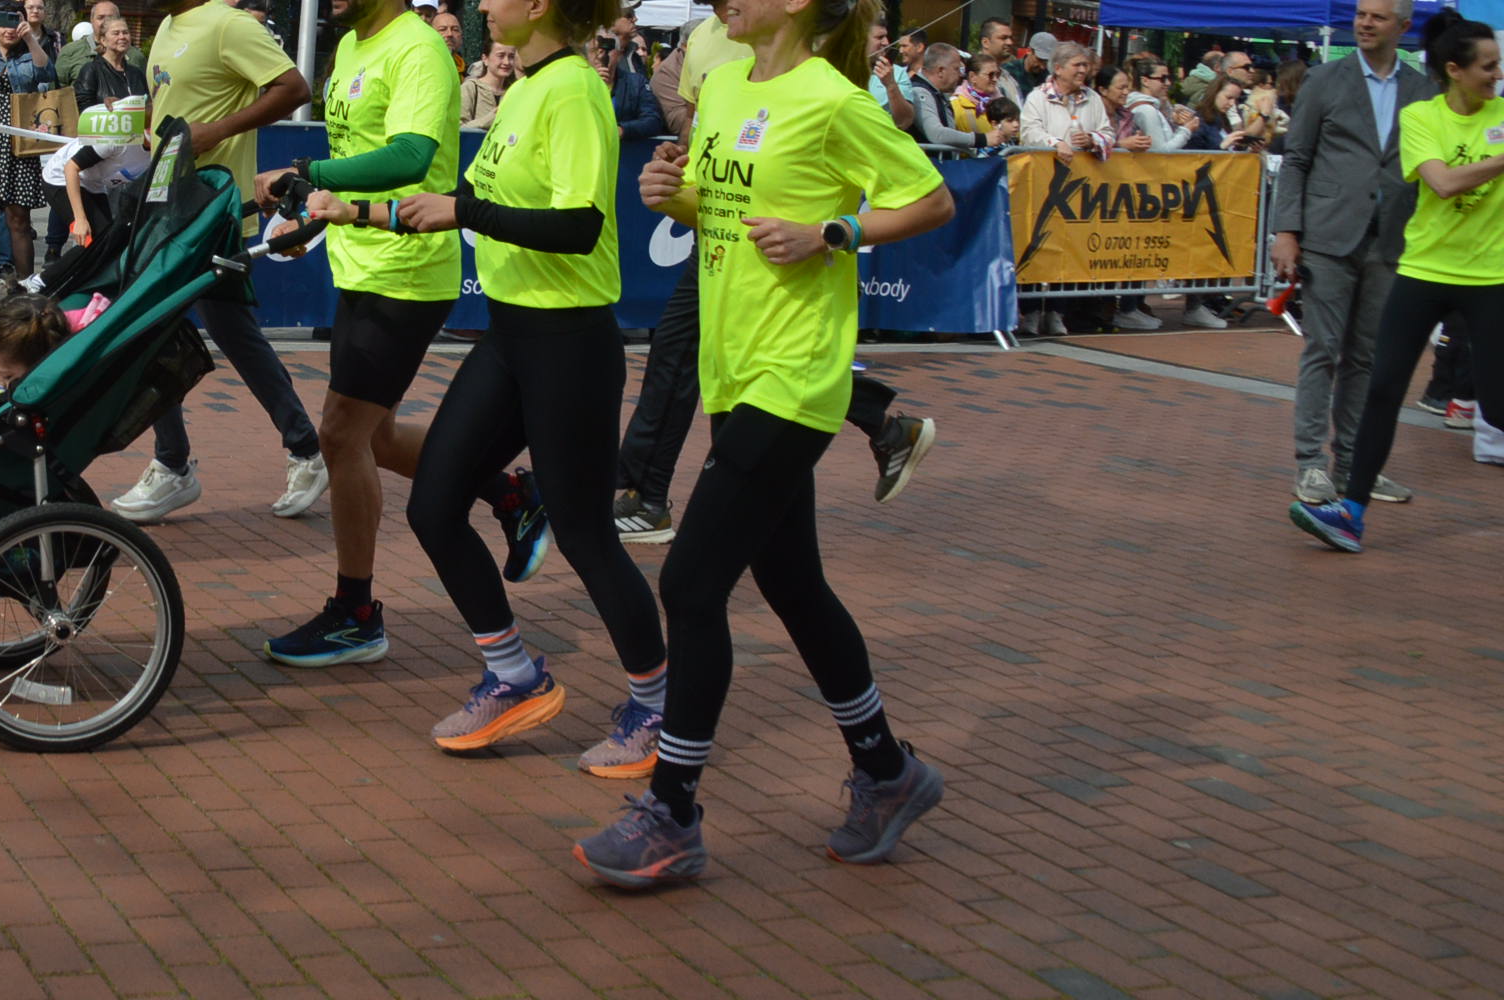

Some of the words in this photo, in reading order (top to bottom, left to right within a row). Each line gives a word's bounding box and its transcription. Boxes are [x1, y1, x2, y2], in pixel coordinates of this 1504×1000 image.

[90, 114, 132, 133] 1736
[715, 188, 751, 204] those
[714, 207, 747, 220] can't
[1016, 157, 1236, 272] КИЛЪРИ
[1105, 236, 1131, 251] 0700
[1135, 236, 1141, 250] 1
[1088, 254, 1170, 272] www.kilari.bg
